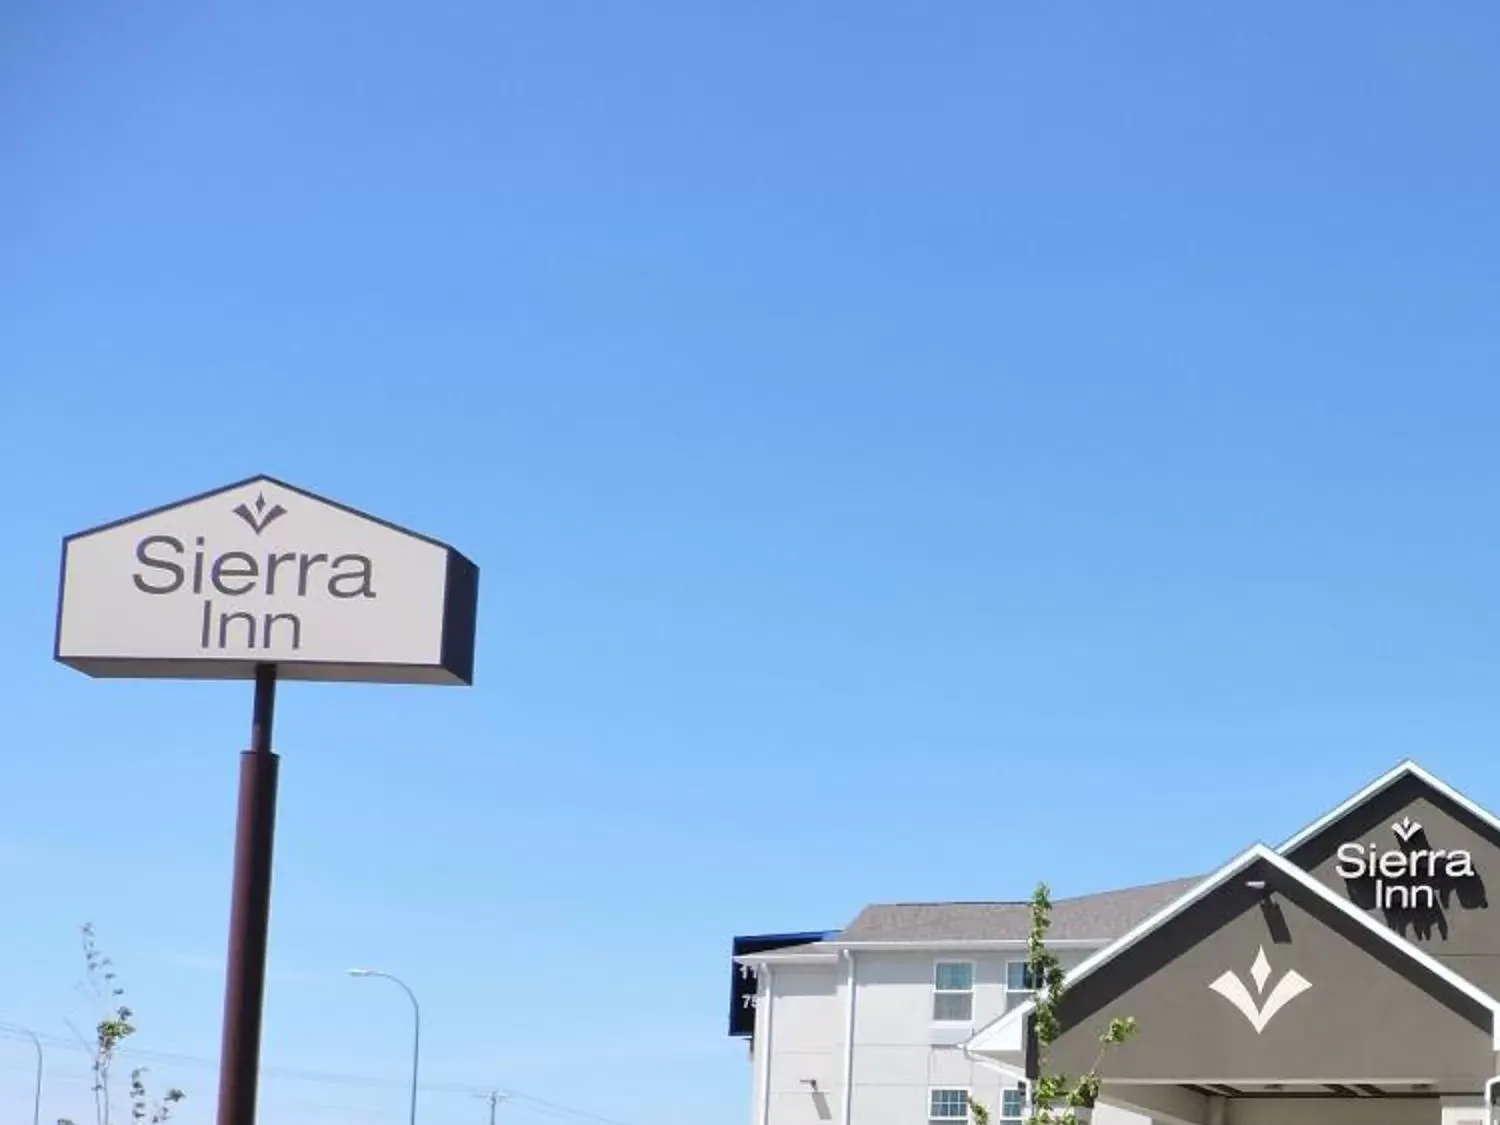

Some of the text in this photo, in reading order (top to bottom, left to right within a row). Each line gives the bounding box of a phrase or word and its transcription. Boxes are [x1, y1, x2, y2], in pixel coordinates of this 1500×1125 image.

[132, 535, 377, 599] Sierra
[201, 600, 301, 650] Inn
[1335, 843, 1475, 879] Sierra
[1375, 879, 1434, 909] Inn
